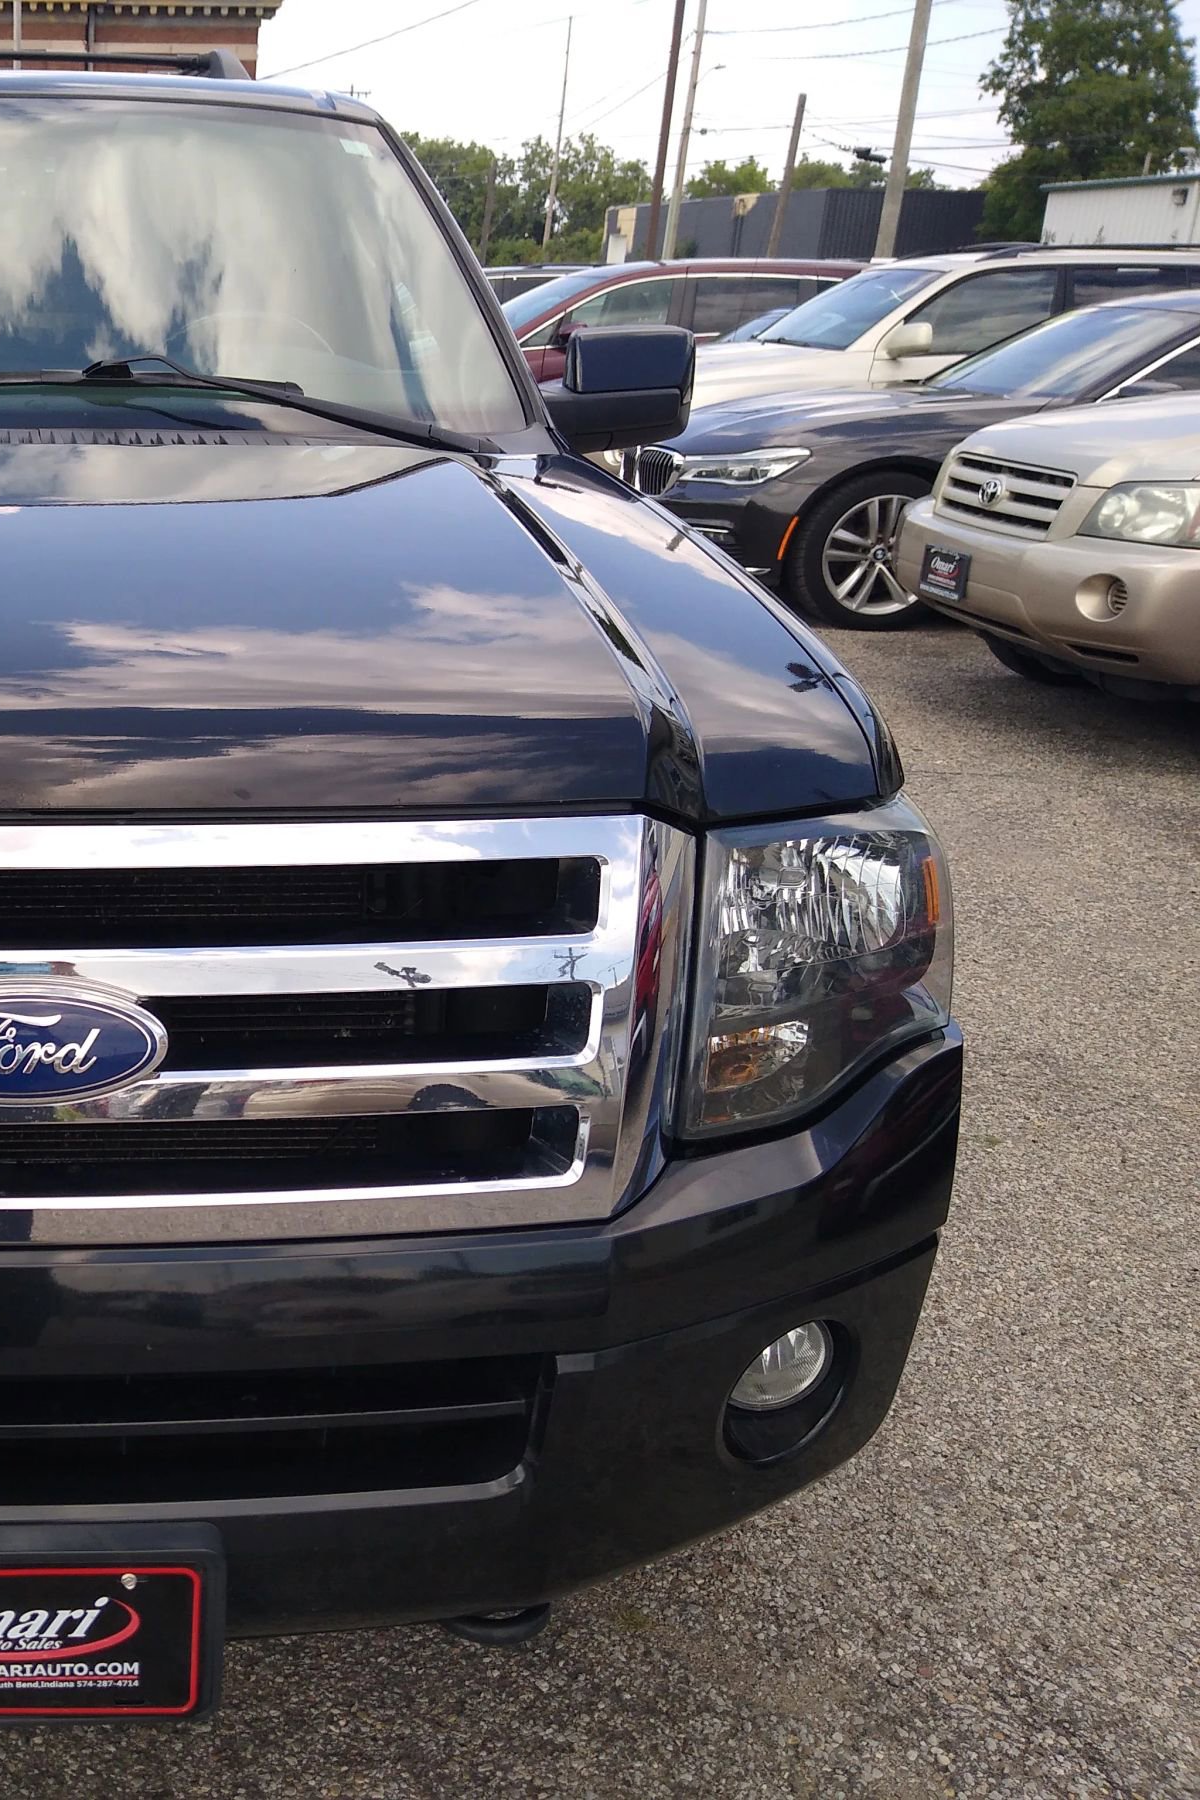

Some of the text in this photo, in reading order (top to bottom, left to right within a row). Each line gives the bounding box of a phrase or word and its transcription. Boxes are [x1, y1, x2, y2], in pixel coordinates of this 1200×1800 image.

[930, 556, 957, 574] Omari
[14, 1637, 63, 1651] Sales
[76, 1679, 140, 1688] 574-287-4714
